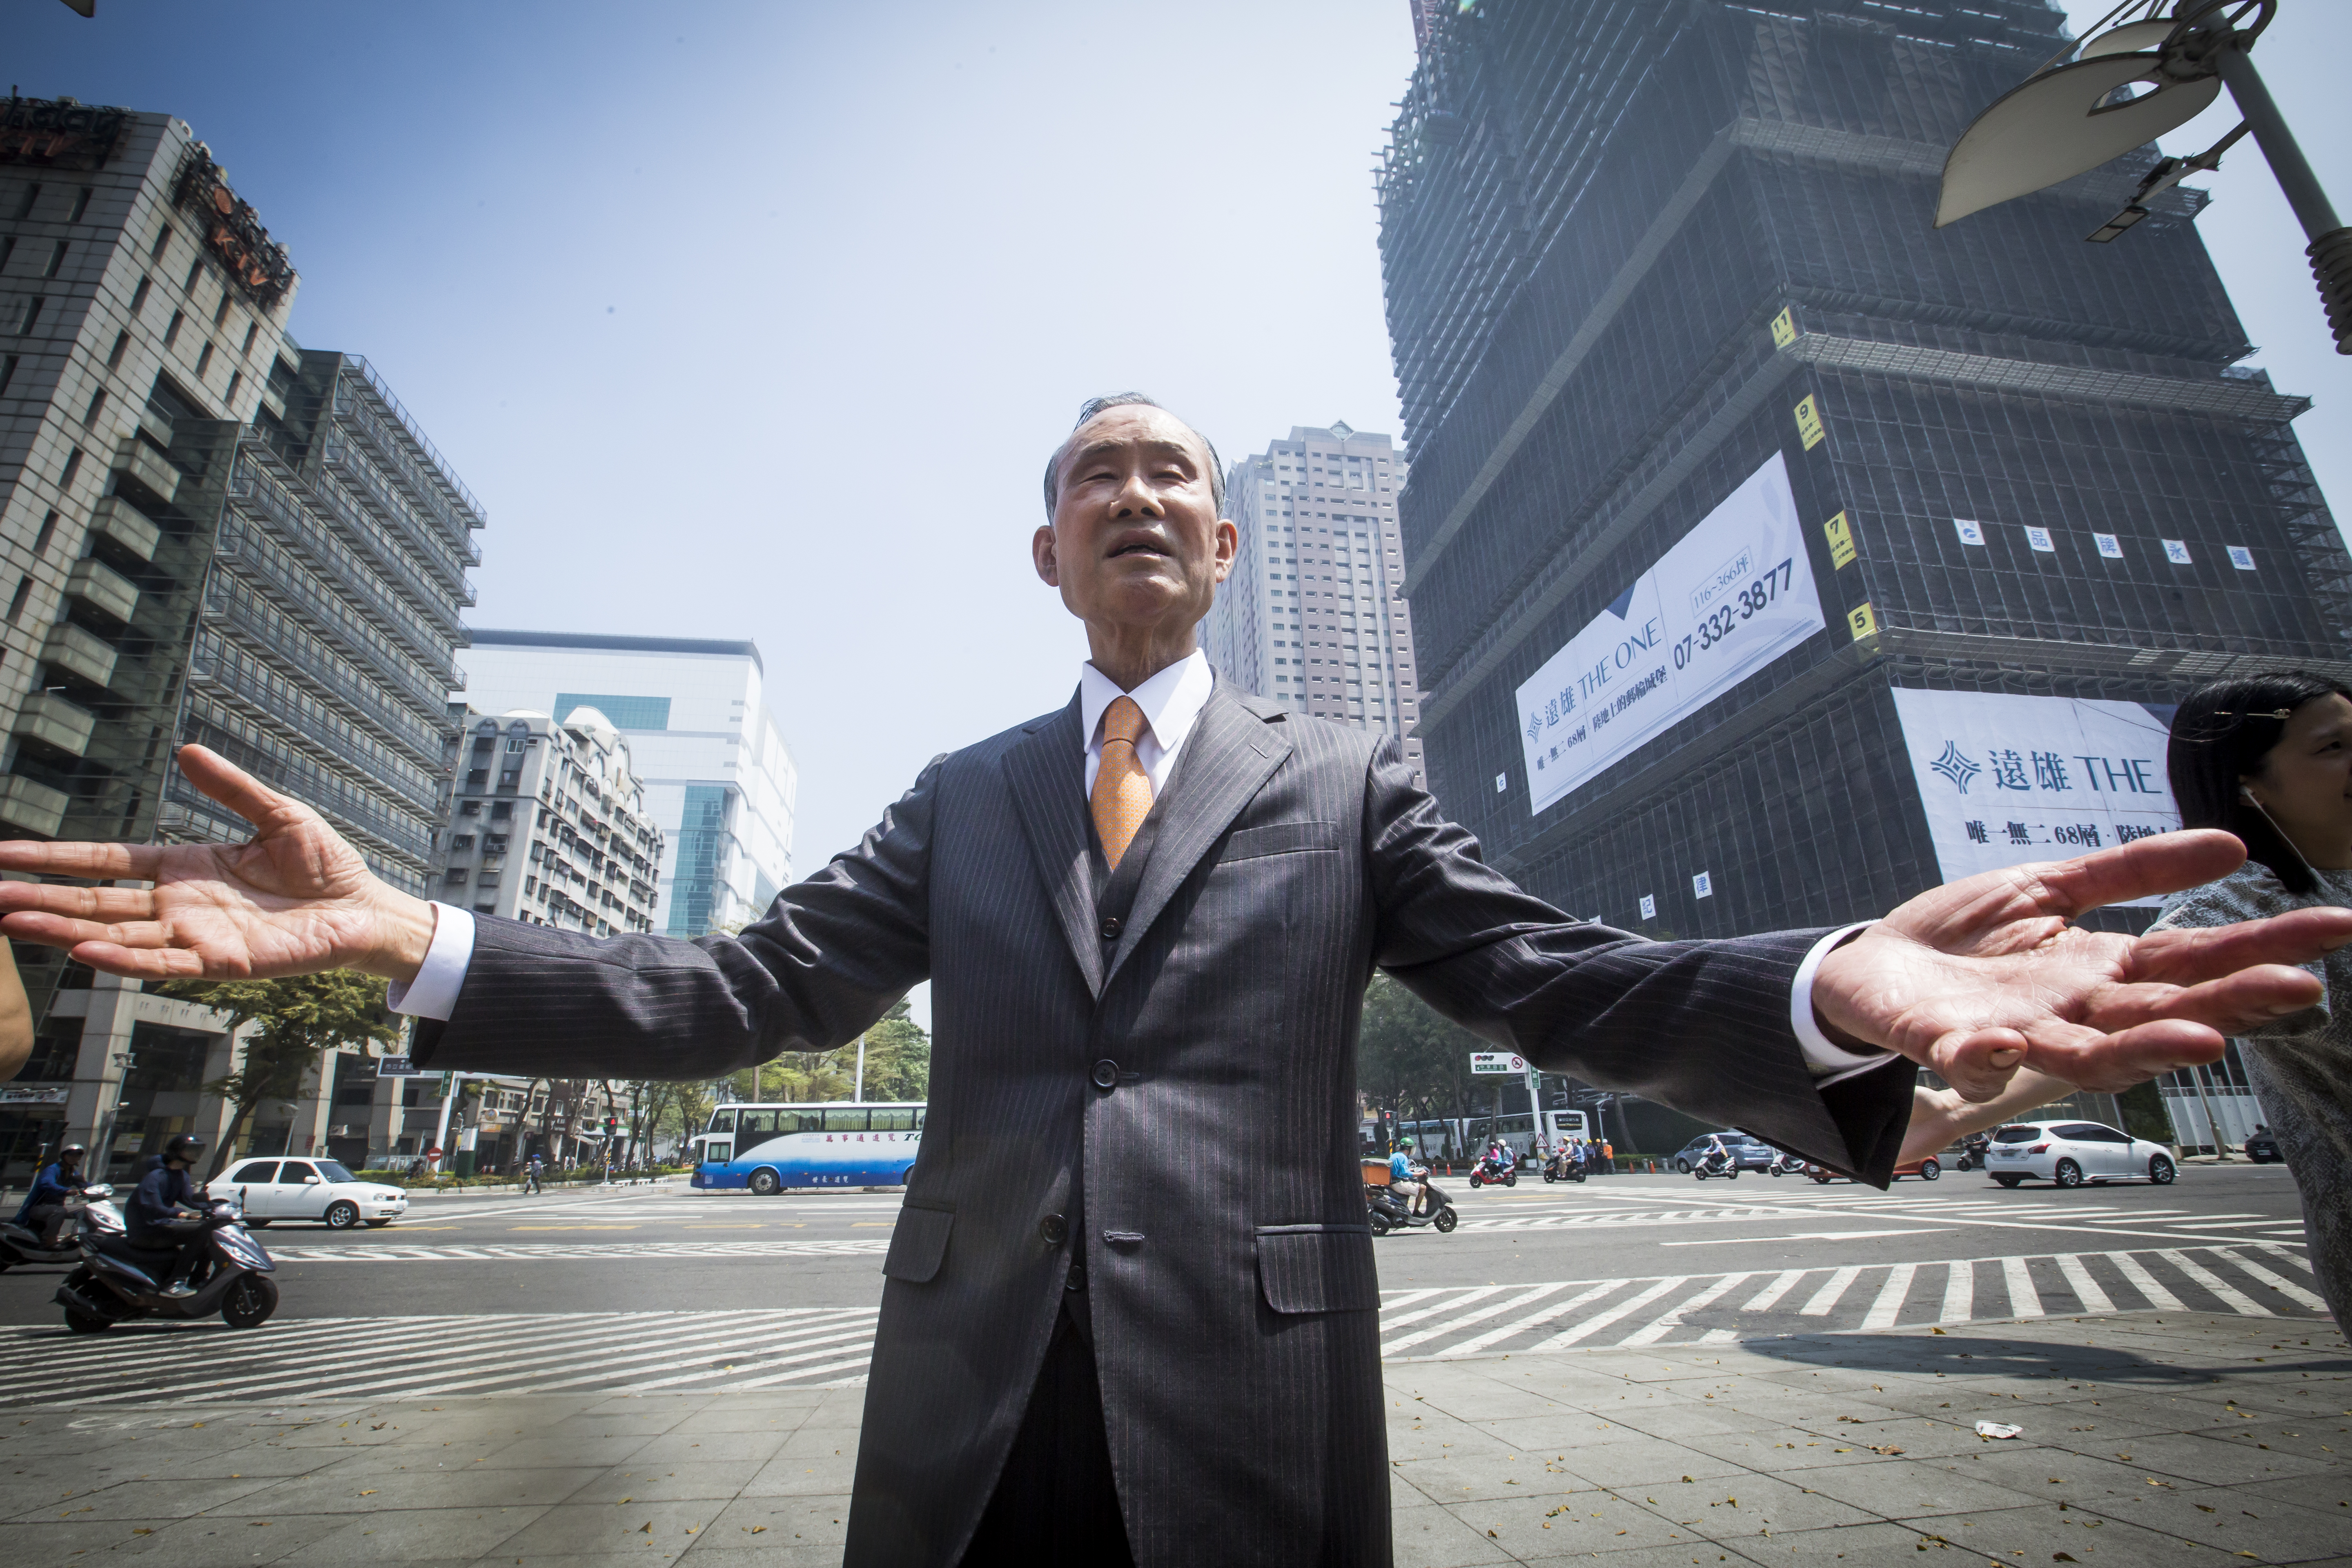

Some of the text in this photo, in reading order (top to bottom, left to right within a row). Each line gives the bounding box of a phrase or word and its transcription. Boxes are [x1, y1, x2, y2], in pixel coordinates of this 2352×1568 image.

[0, 85, 127, 145] liday
[212, 227, 269, 285] KTV
[1774, 313, 1787, 333] 11
[1800, 404, 1808, 419] 9
[1830, 519, 1839, 535] 7
[1694, 554, 1749, 608] 116~366坪
[1674, 557, 1792, 670] 07-332-3877
[1855, 611, 1866, 629] 5
[1545, 617, 1662, 728] 遠雄 THE ONE
[1537, 665, 1668, 771] 唯一無二 68層 陸地上的郵輪城堡
[1988, 750, 2163, 794] 遠雄 THE
[1965, 820, 2051, 845] 唯一無二
[2054, 824, 2101, 847] 68層
